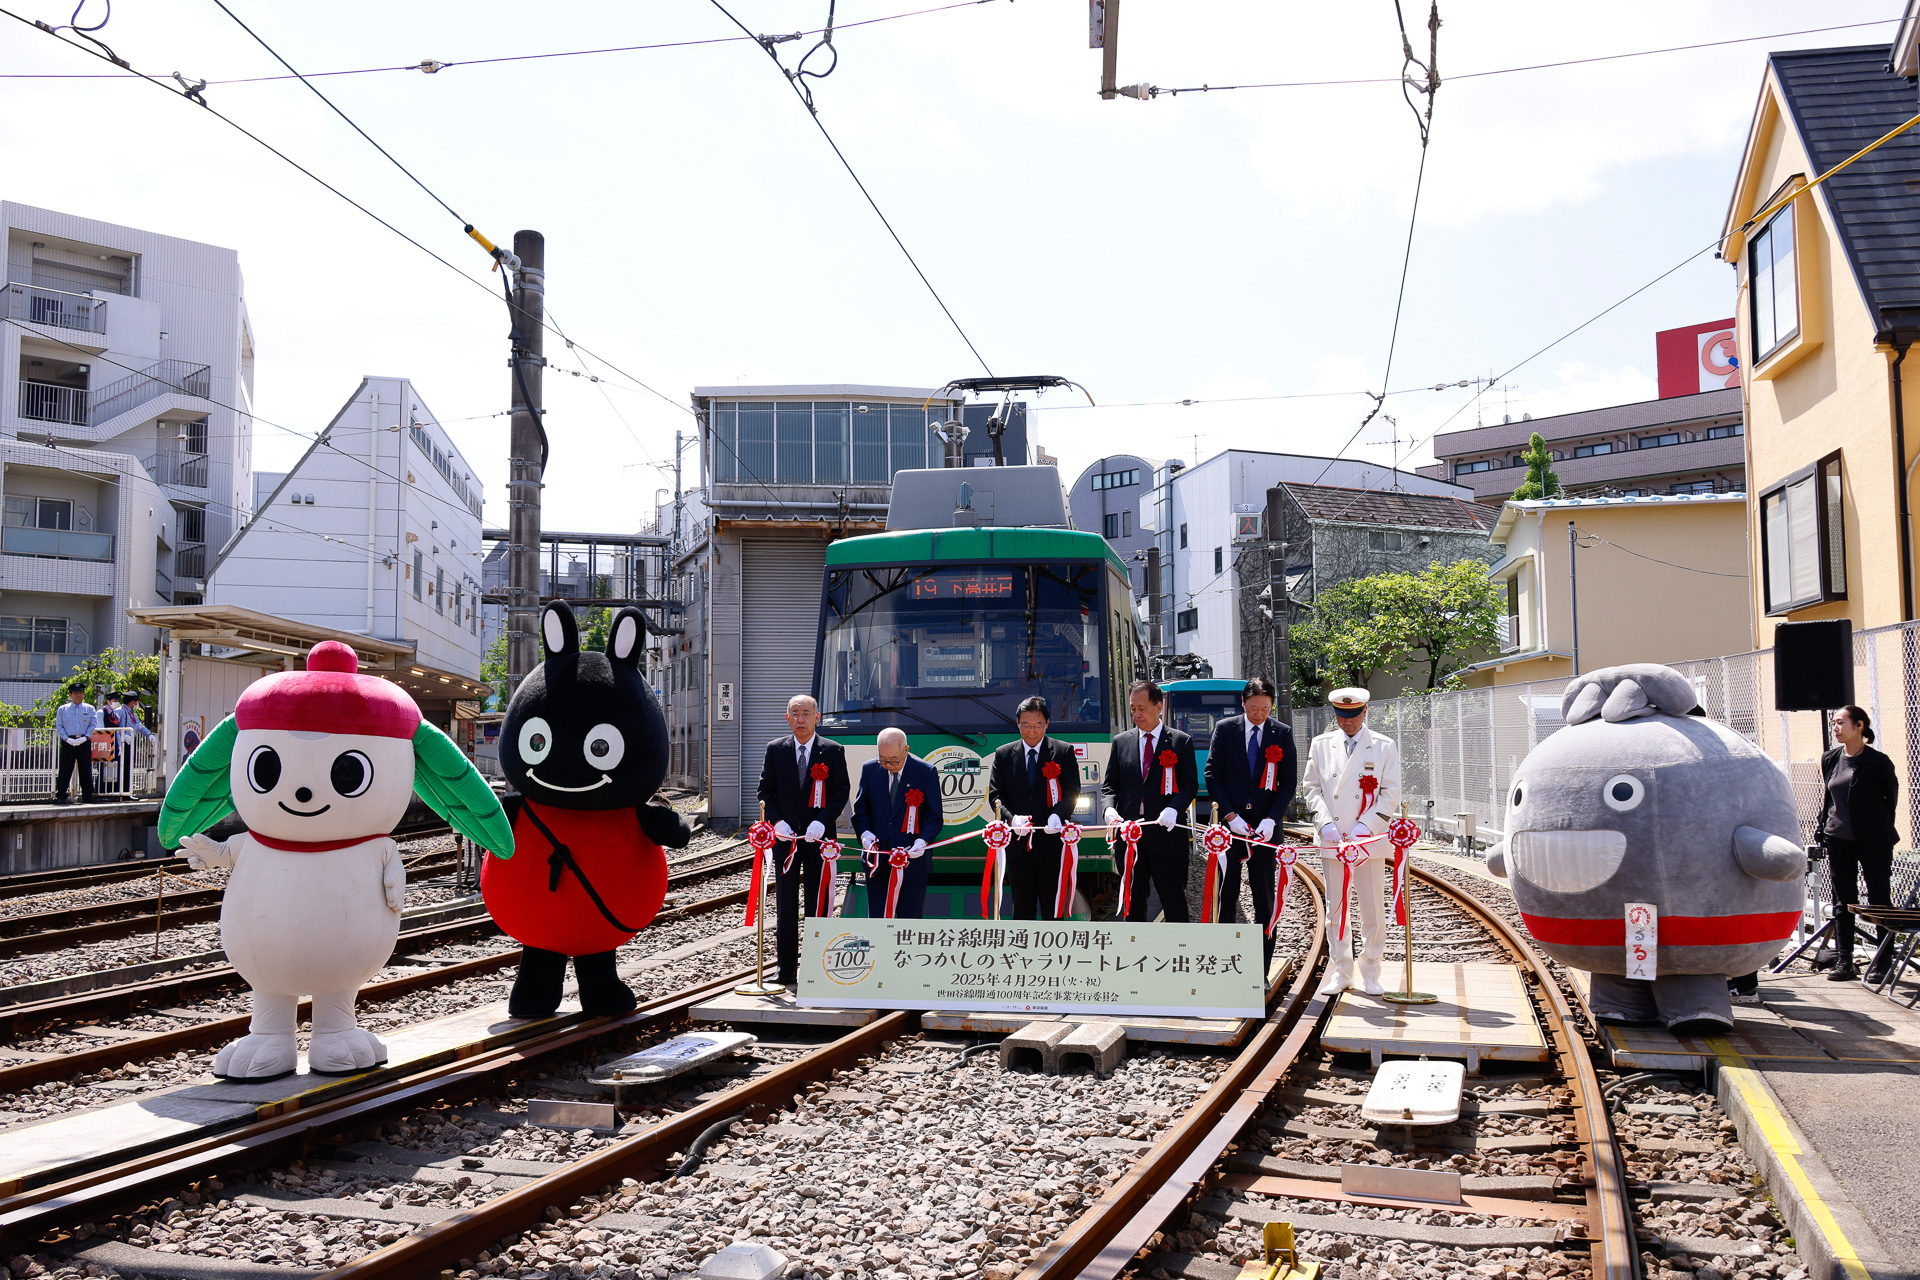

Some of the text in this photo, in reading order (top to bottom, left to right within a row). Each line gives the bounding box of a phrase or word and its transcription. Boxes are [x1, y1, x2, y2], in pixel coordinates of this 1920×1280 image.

[1240, 518, 1257, 533] 入
[941, 772, 975, 797] 00
[893, 928, 1113, 950] 世田谷線開通100周年
[834, 950, 865, 968] 100
[894, 949, 1242, 975] なつかしのギャラリートレイン出発式
[937, 989, 1120, 1002] 世田谷線開通100周年記念事業実行委員会
